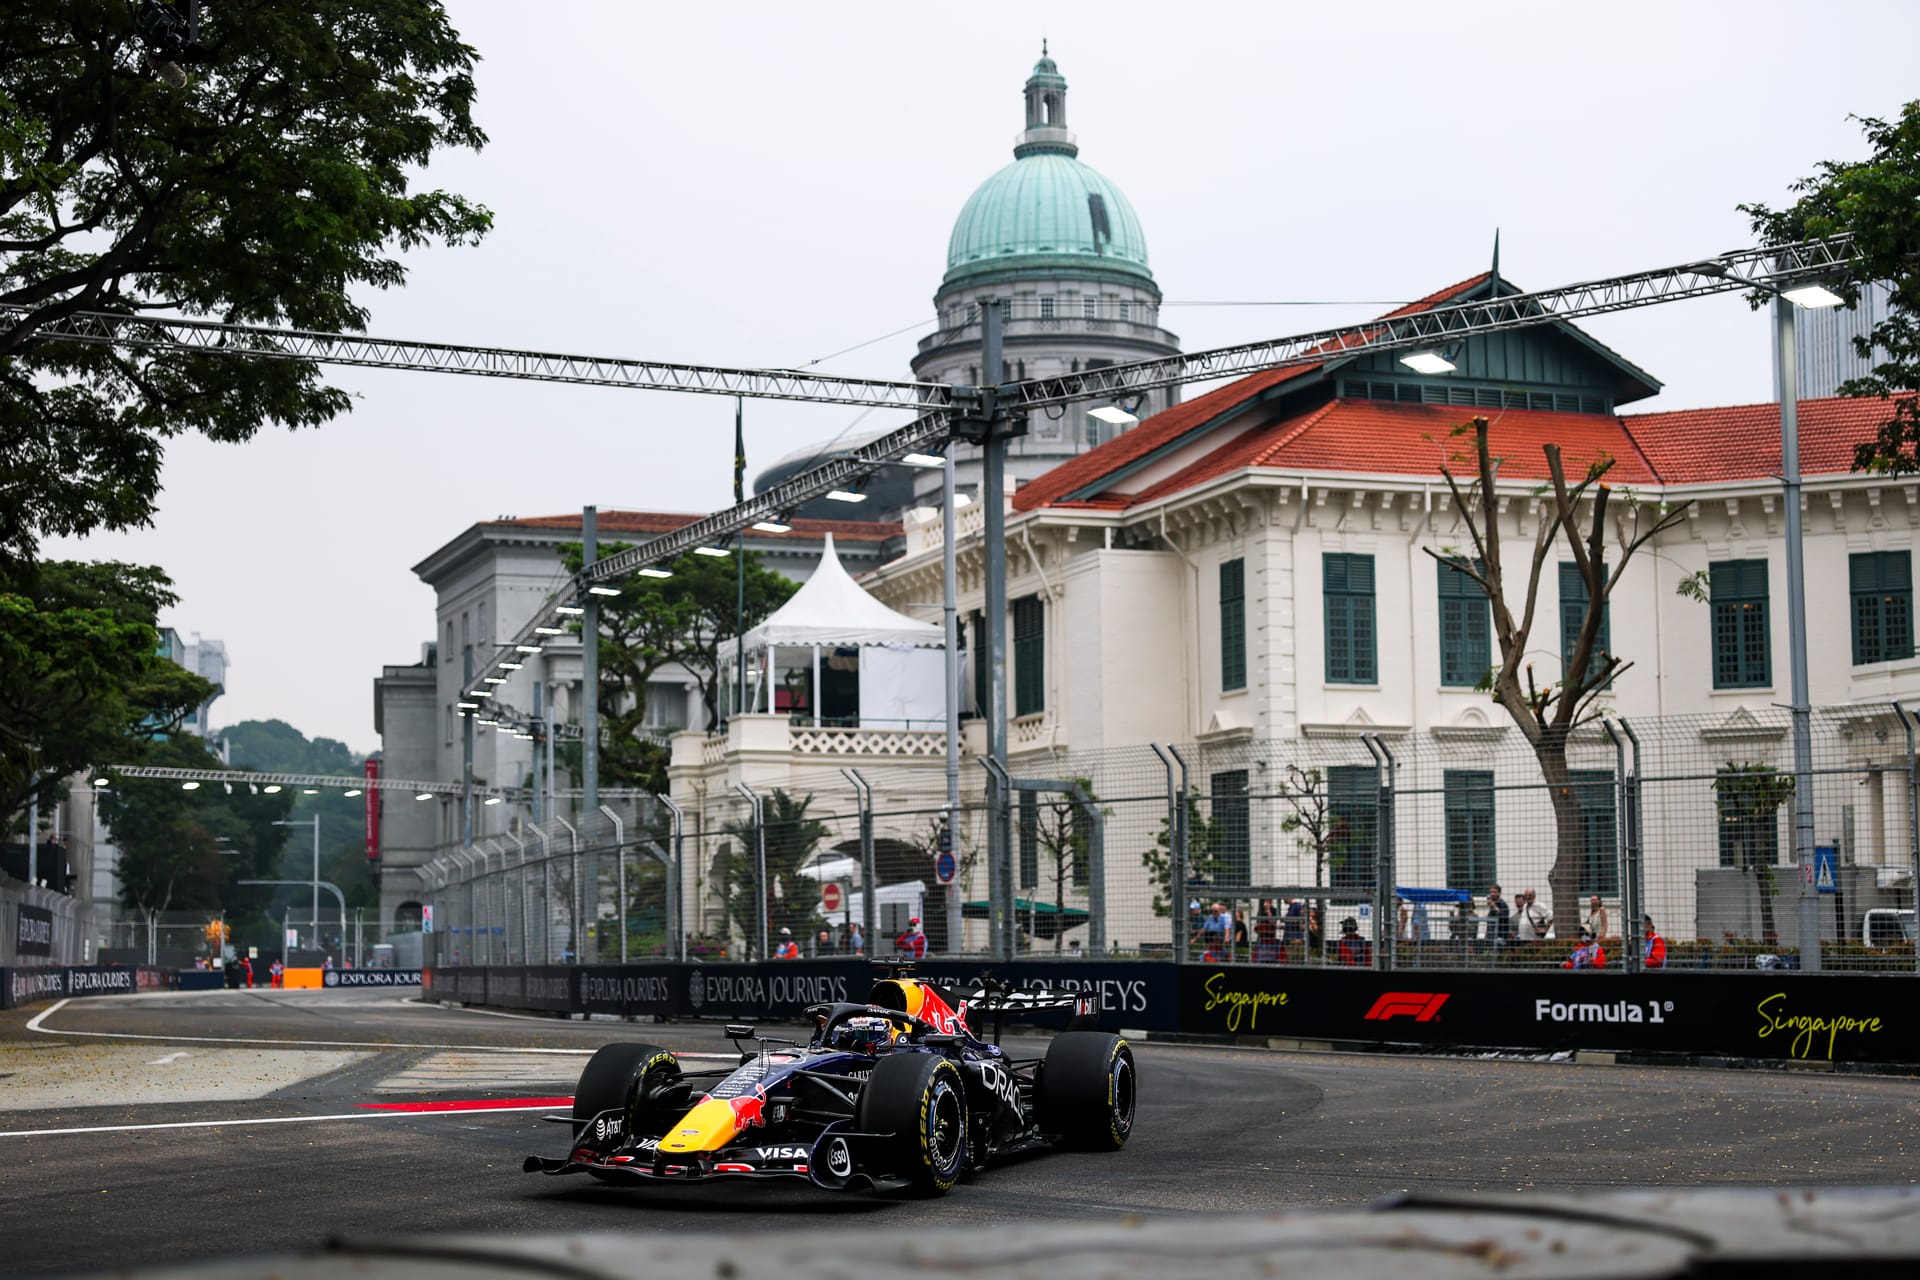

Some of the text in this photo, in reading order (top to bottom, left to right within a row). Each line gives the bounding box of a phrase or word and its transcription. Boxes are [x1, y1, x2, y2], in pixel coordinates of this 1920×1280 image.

[341, 973, 392, 985] EXPLORA
[589, 977, 622, 1001] EXPLORA
[623, 976, 668, 1006] JOURNEYS
[706, 975, 848, 1010] EXPLORA JOURNEYS
[1075, 997, 1092, 1016] Mobil
[1204, 972, 1289, 1032] Singapore
[1363, 992, 1451, 1022] F1
[1535, 999, 1643, 1023] Formula
[1758, 993, 1884, 1059] Singapore
[648, 1053, 676, 1069] ZERO
[606, 1119, 623, 1137] AT&T
[919, 1088, 930, 1150] ZERO
[756, 1147, 808, 1159] VISA
